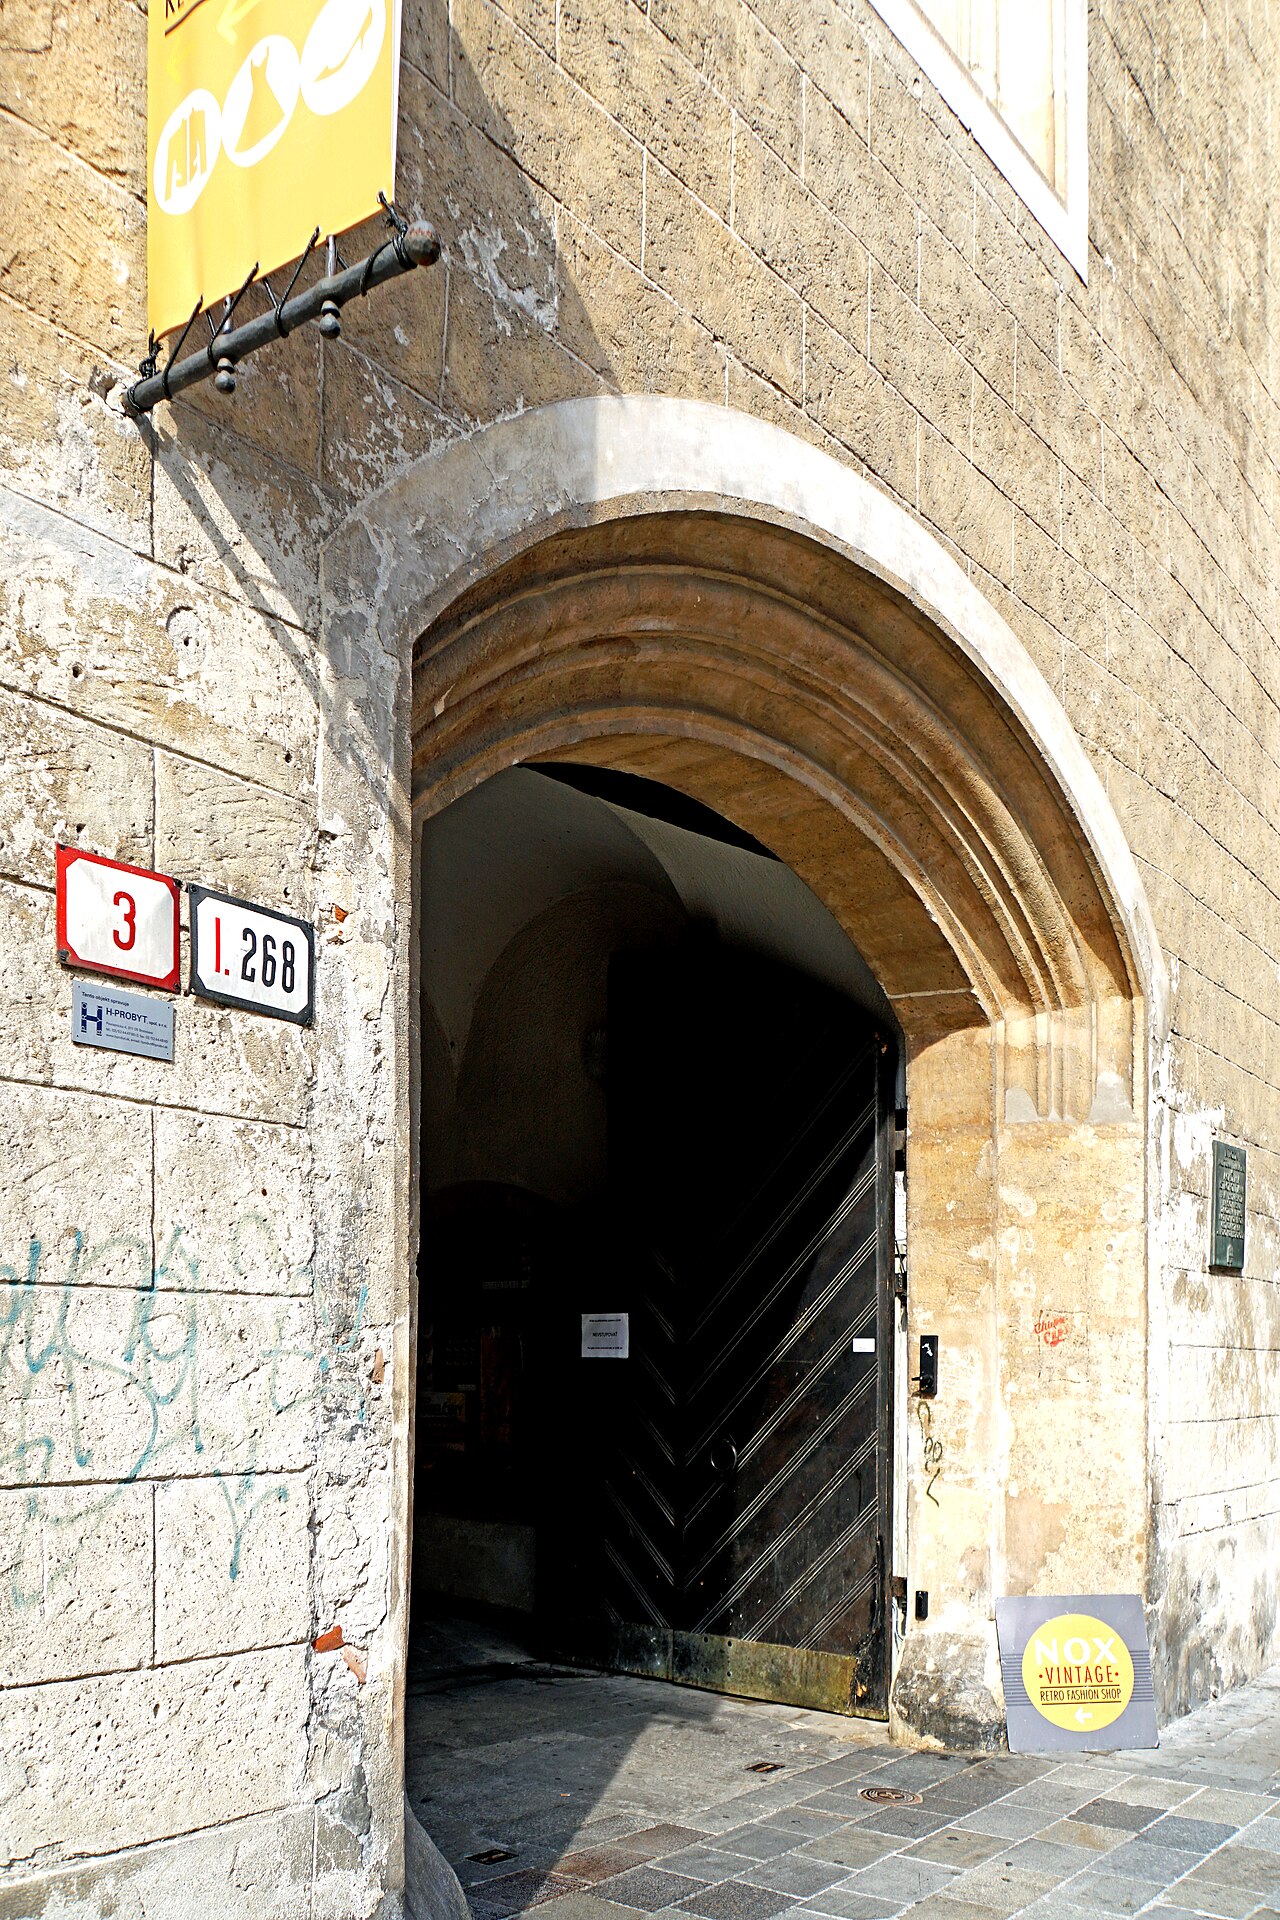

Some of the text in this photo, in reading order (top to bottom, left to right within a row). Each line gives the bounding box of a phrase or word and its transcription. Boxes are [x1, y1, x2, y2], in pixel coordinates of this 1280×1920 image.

[113, 891, 136, 950] 3
[241, 927, 295, 994] 268
[1034, 1636, 1118, 1665] NOX
[1045, 1665, 1113, 1684] VINTAGE
[1040, 1688, 1122, 1702] RETRO FASHION SHOP
